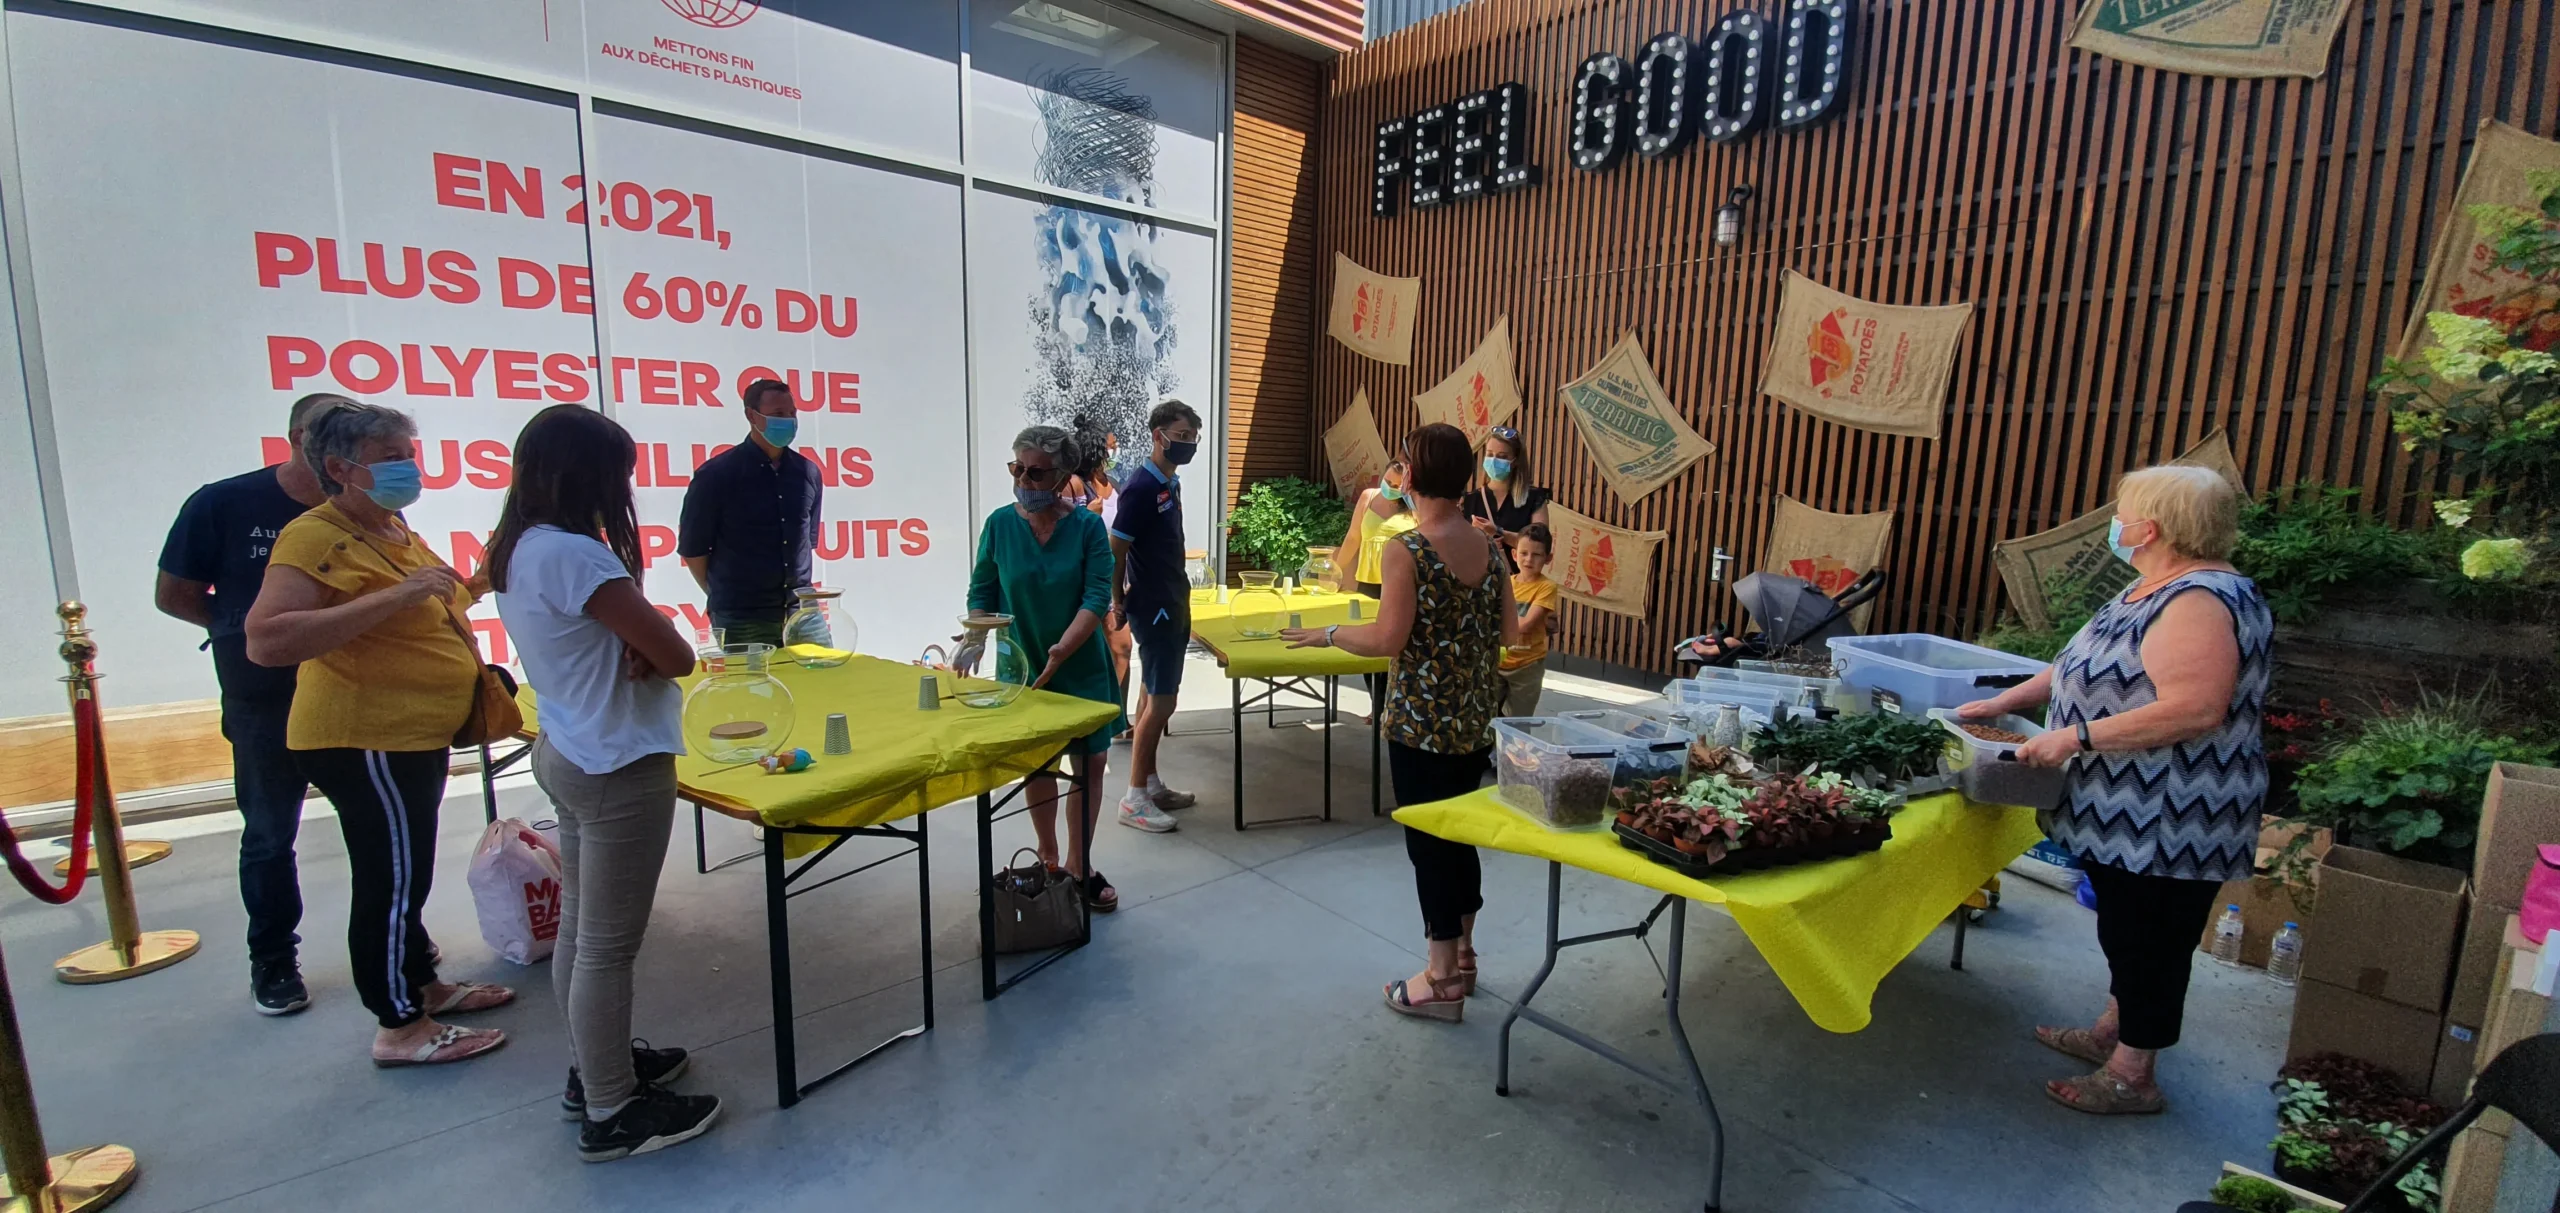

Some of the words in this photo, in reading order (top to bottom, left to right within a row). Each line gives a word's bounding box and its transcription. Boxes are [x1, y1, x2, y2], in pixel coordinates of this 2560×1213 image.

[601, 43, 635, 61] AUX
[638, 51, 711, 79] DÉCHETS
[713, 69, 802, 100] PLASTIQUES
[653, 36, 729, 65] METTONS
[731, 55, 754, 71] FIN
[1373, 82, 1541, 219] FEEL
[1568, 0, 1856, 173] GOOD
[432, 152, 545, 219] EN
[561, 175, 732, 251] 2021,
[253, 231, 481, 305] PLUS
[498, 256, 597, 315] DE
[622, 271, 763, 331] 60%
[775, 289, 859, 338] DU
[1371, 288, 1383, 339] POTATOES
[267, 335, 724, 408] POLYESTER
[1850, 318, 1877, 395] POTATOES
[1578, 386, 1667, 443] TERRIFIC
[250, 544, 268, 559] je
[1564, 527, 1581, 588] POTATOES
